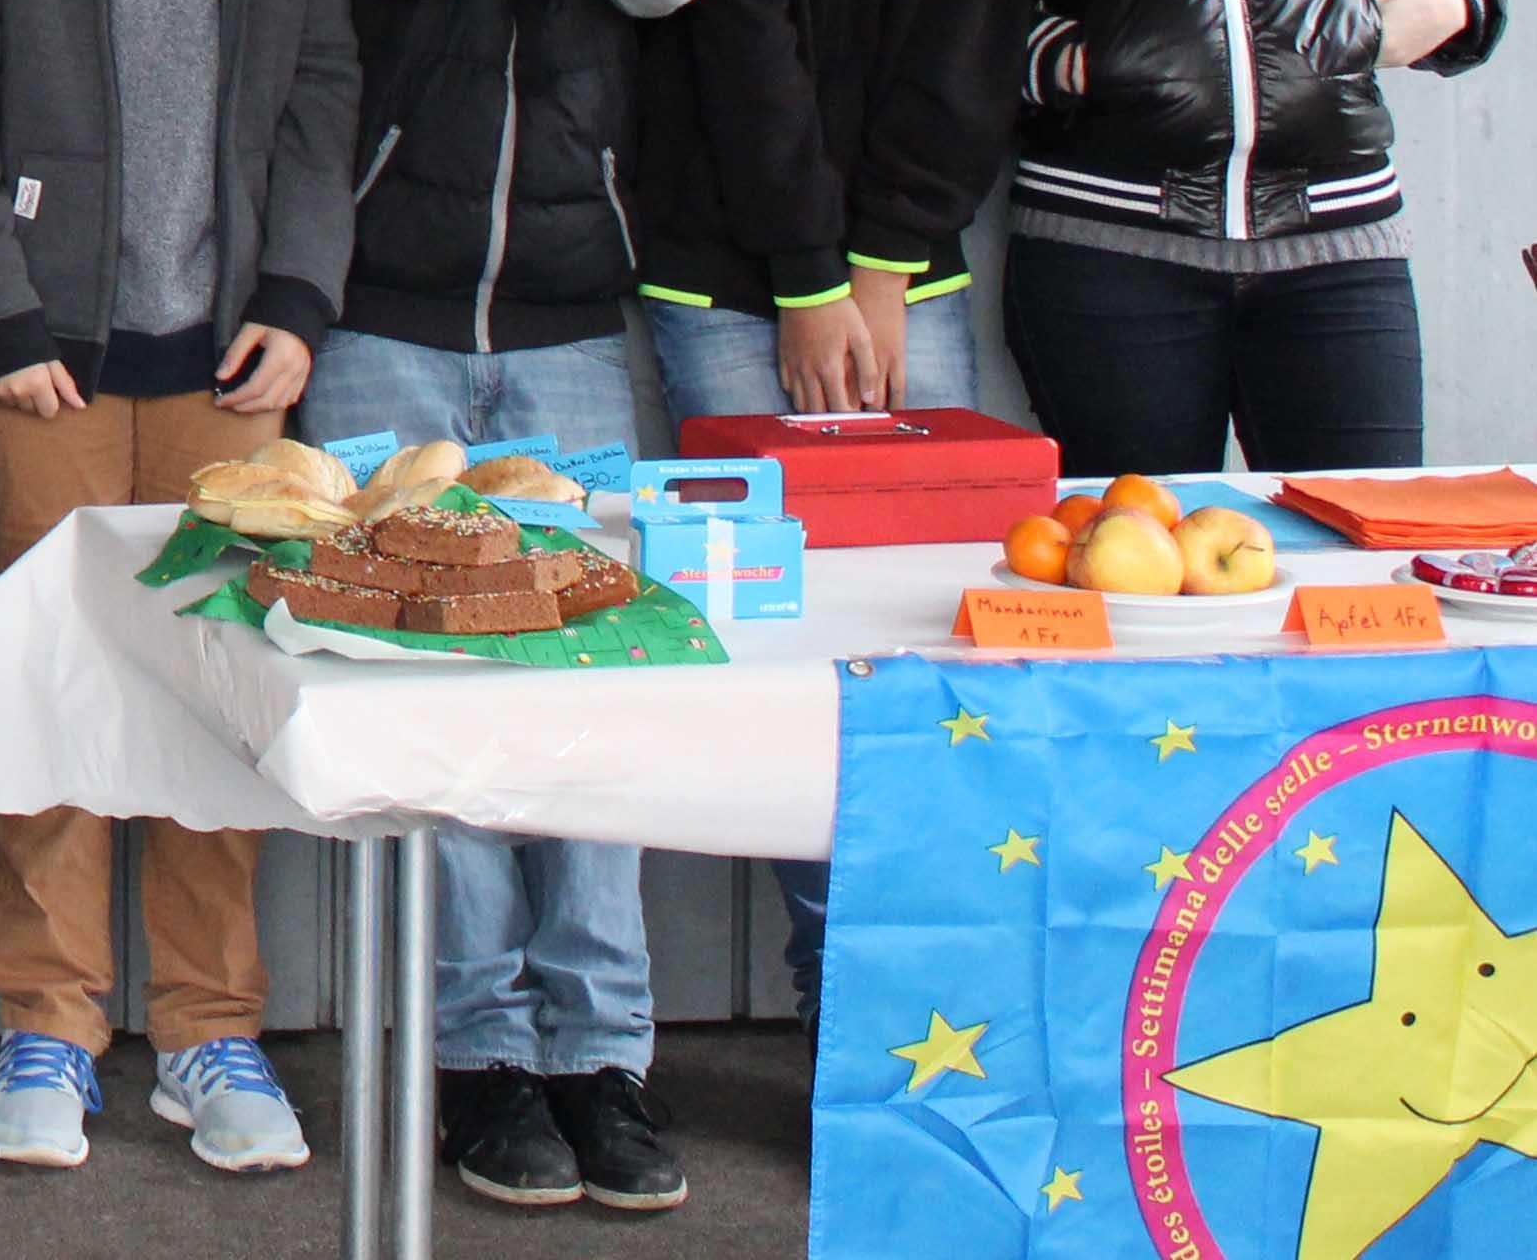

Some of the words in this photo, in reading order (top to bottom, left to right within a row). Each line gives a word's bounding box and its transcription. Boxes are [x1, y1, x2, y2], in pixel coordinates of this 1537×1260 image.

[977, 597, 1084, 618] Mandarinen
[1265, 751, 1333, 816] stelle
[1198, 812, 1264, 884] delle
[1132, 889, 1207, 1058] Settimana
[1133, 1099, 1174, 1204] étoiles
